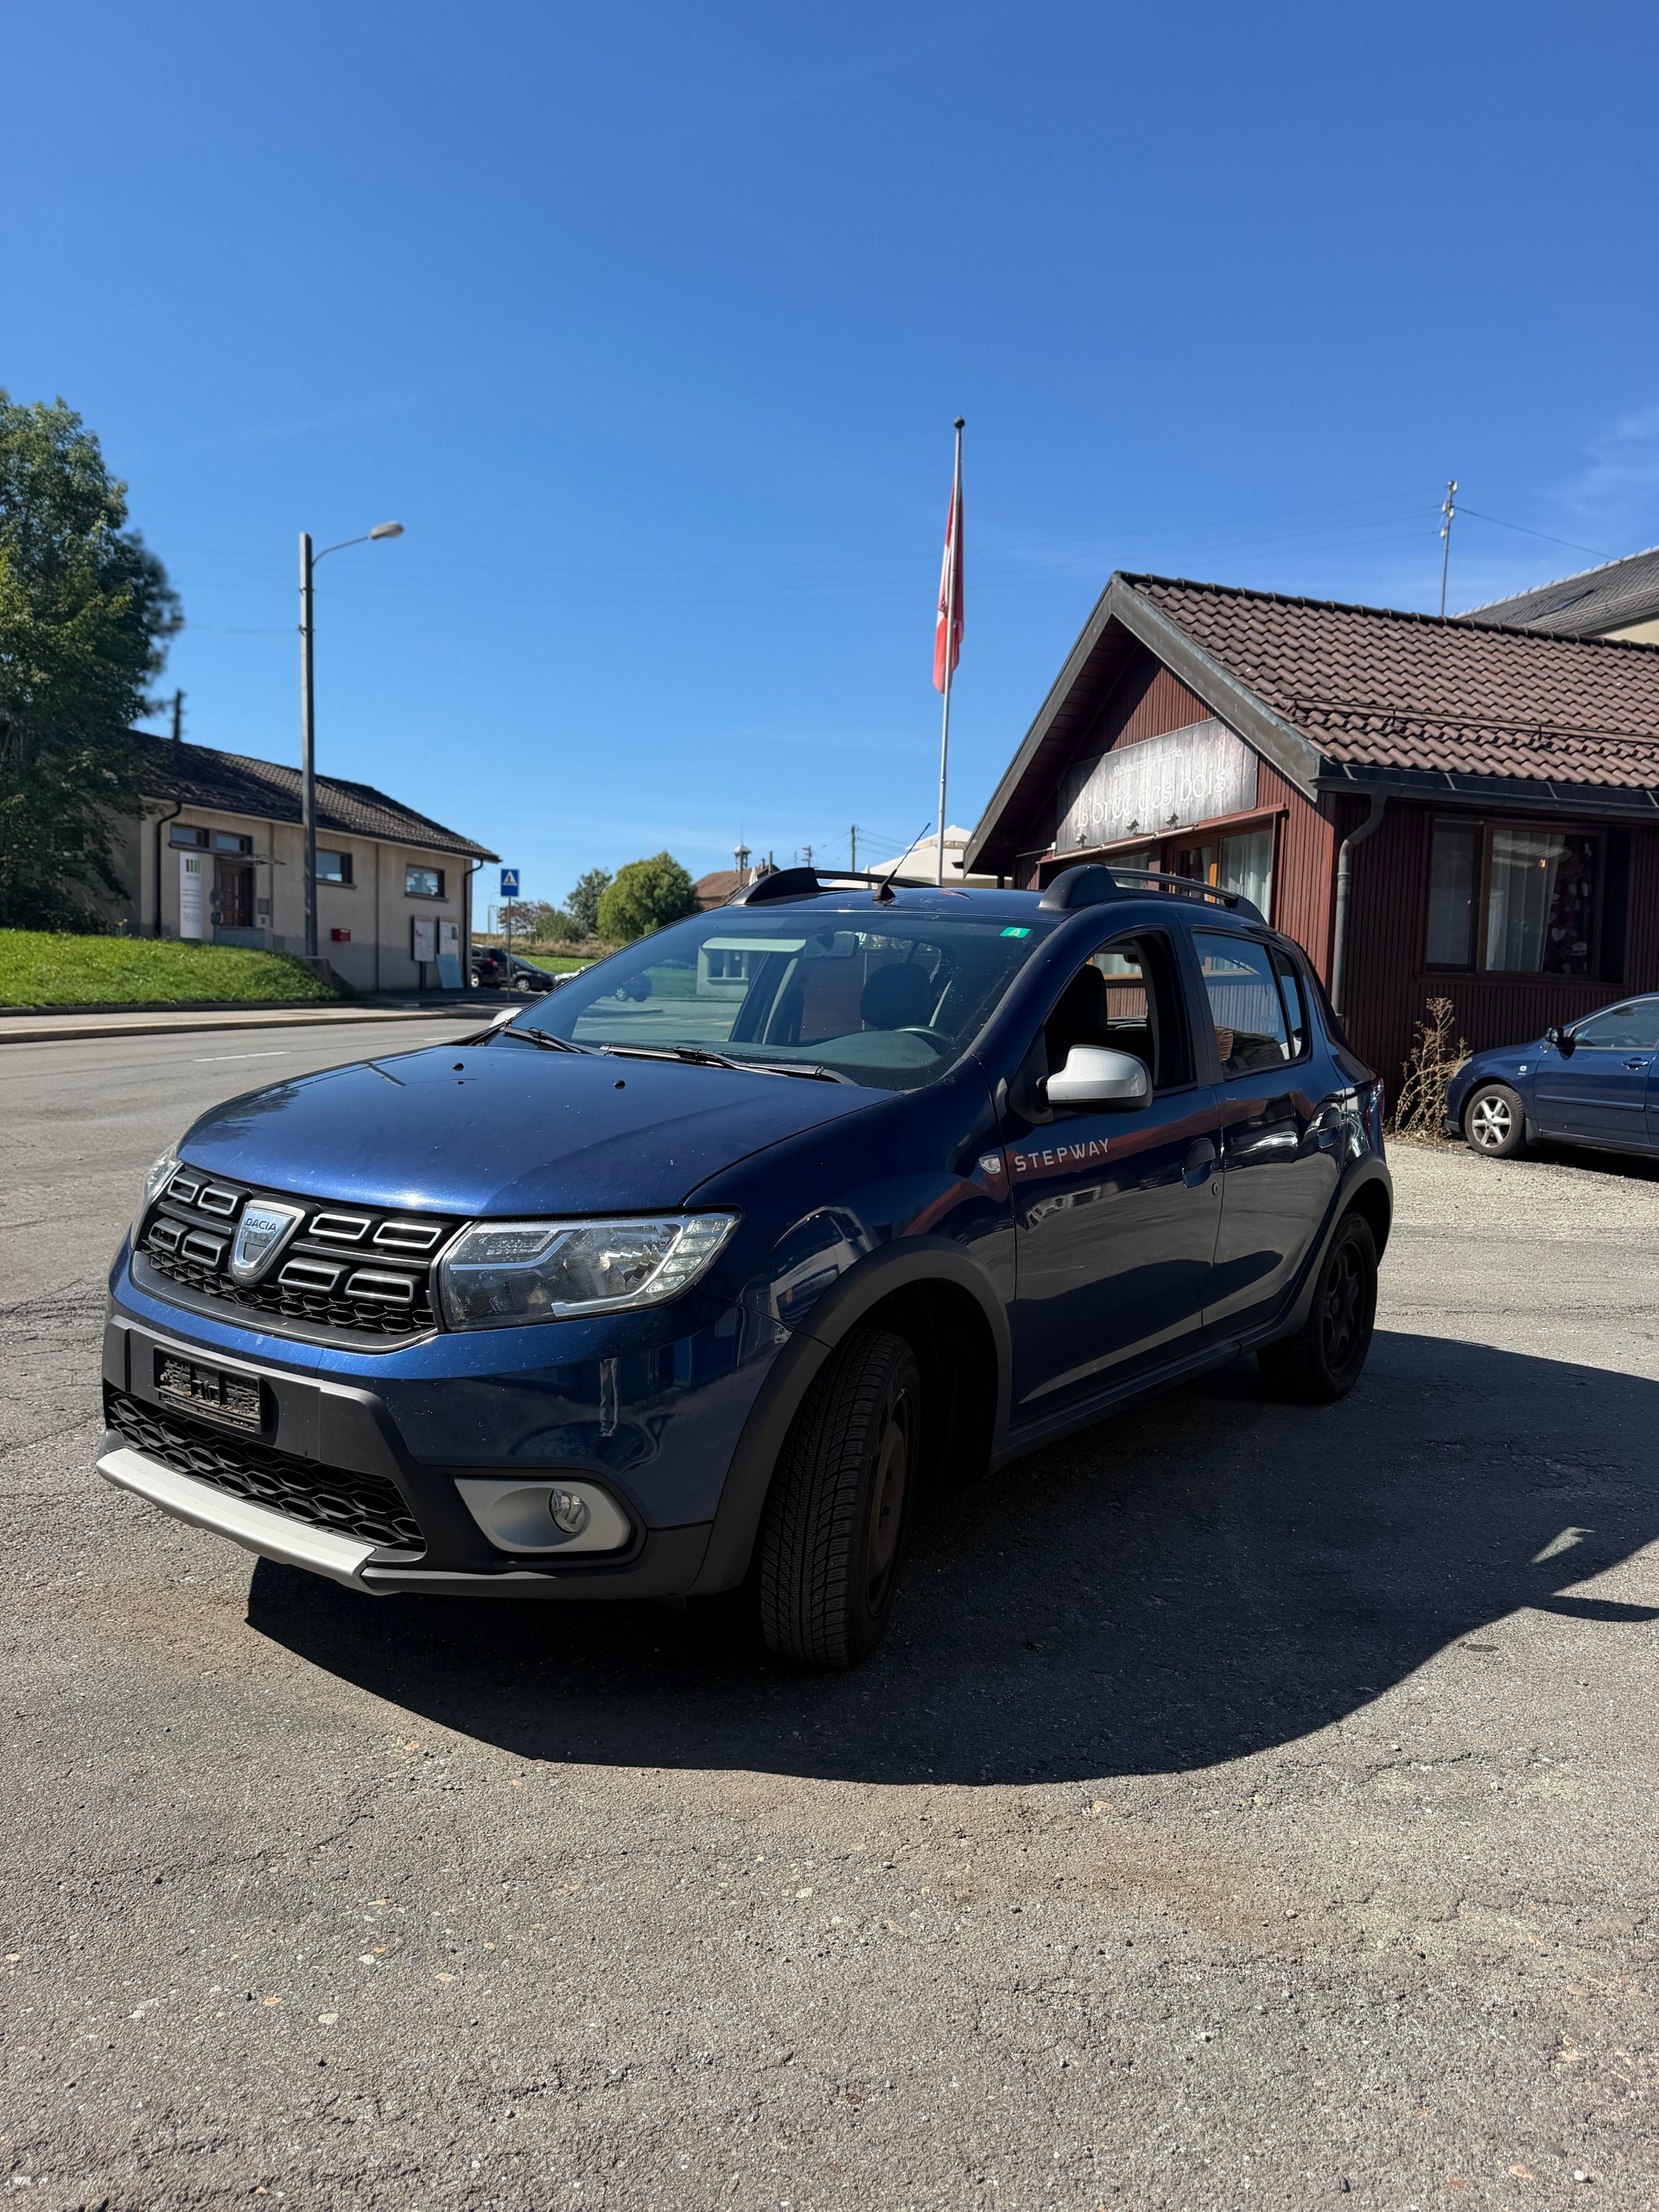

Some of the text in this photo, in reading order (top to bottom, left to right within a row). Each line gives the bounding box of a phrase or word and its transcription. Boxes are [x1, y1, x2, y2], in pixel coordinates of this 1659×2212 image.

[1138, 782, 1173, 812] des
[1179, 764, 1226, 803] bois
[1014, 1138, 1109, 1173] STEPWAY
[245, 1217, 276, 1231] DACIA
